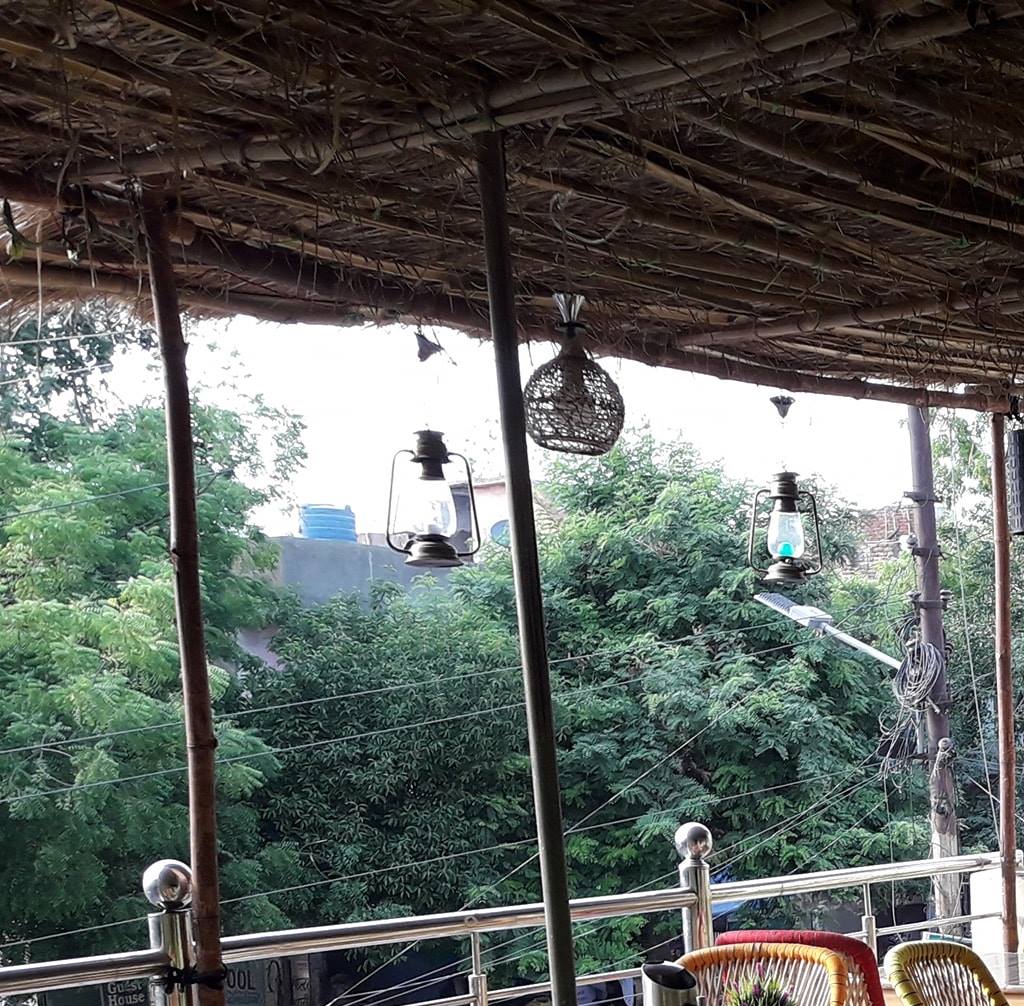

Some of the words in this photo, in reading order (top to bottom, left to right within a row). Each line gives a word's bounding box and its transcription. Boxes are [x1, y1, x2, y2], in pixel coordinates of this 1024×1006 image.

[107, 980, 144, 994] Guest
[226, 969, 257, 991] OOL
[107, 992, 146, 1006] House
